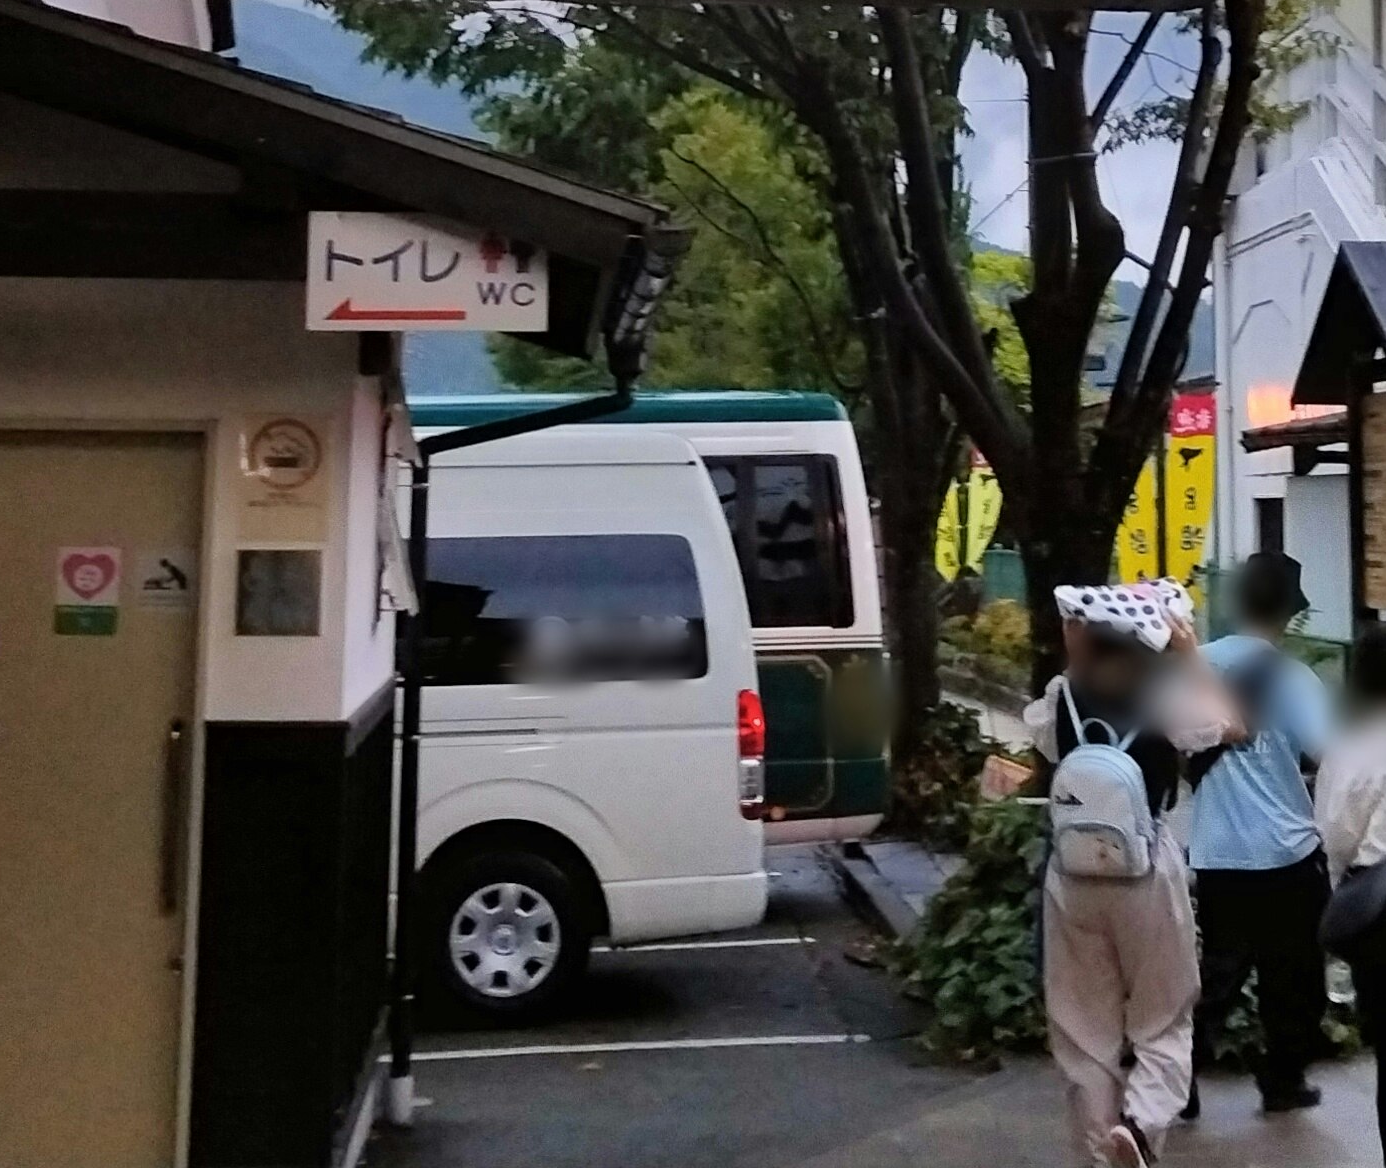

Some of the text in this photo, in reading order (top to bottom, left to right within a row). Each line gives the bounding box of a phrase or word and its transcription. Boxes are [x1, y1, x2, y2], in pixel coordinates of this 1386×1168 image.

[325, 239, 461, 282] トイレ
[476, 281, 536, 307] WC
